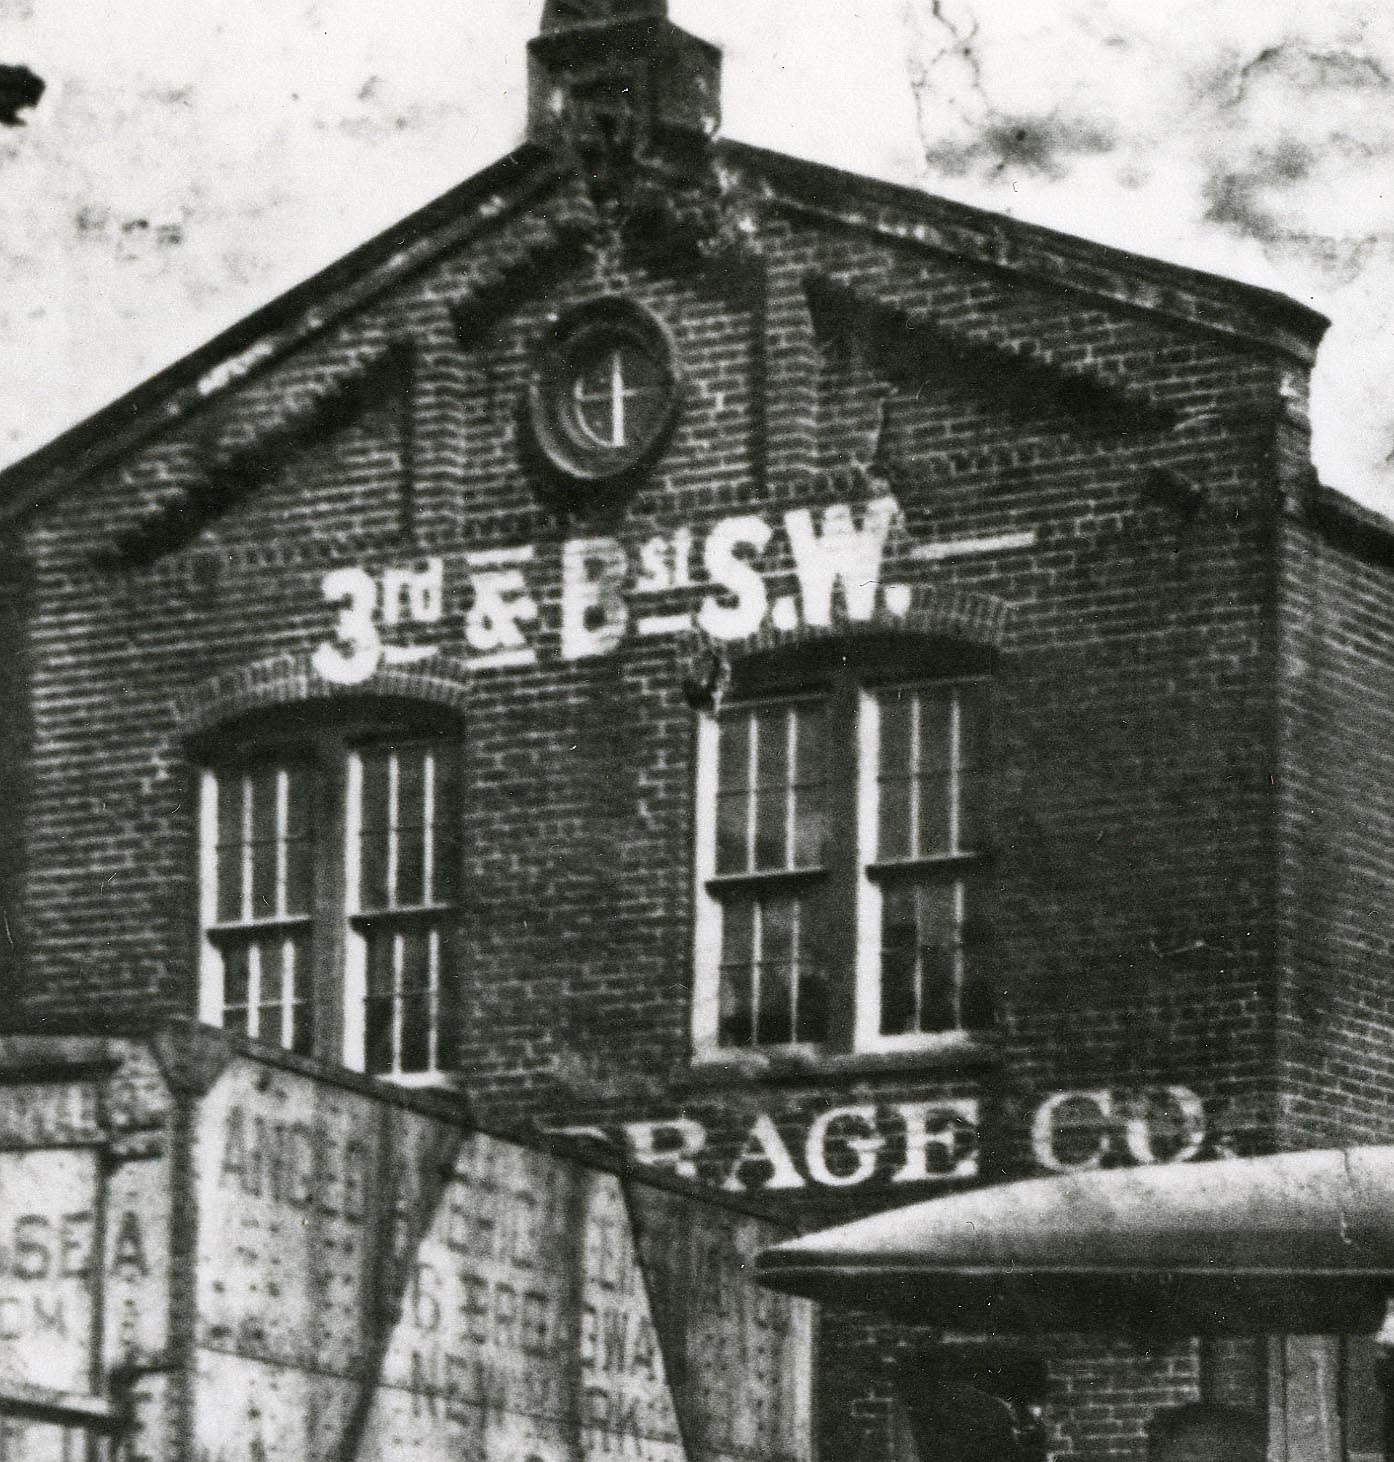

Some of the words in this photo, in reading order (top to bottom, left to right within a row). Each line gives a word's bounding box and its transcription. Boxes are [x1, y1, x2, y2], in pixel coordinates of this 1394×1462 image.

[312, 556, 442, 684] 3rd
[464, 545, 538, 670] &
[698, 495, 912, 641] S.W.
